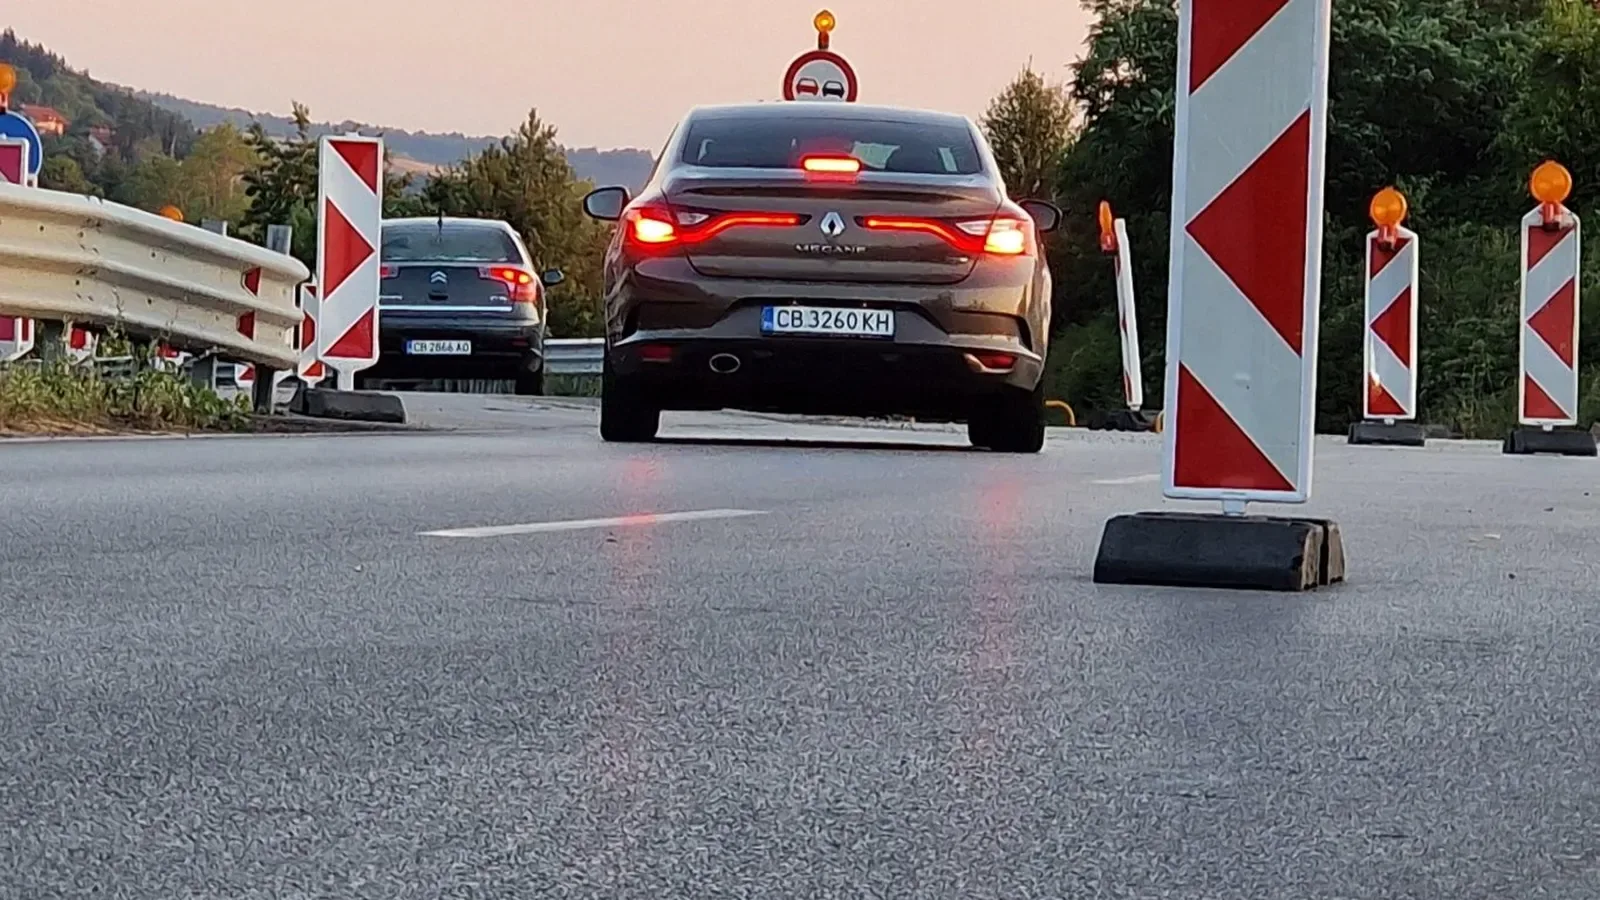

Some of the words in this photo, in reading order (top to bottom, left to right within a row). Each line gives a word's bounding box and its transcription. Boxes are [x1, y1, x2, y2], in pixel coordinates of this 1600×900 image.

[795, 244, 867, 254] MEGANE
[777, 309, 803, 328] CB
[808, 310, 858, 330] 3260
[862, 312, 889, 332] KH
